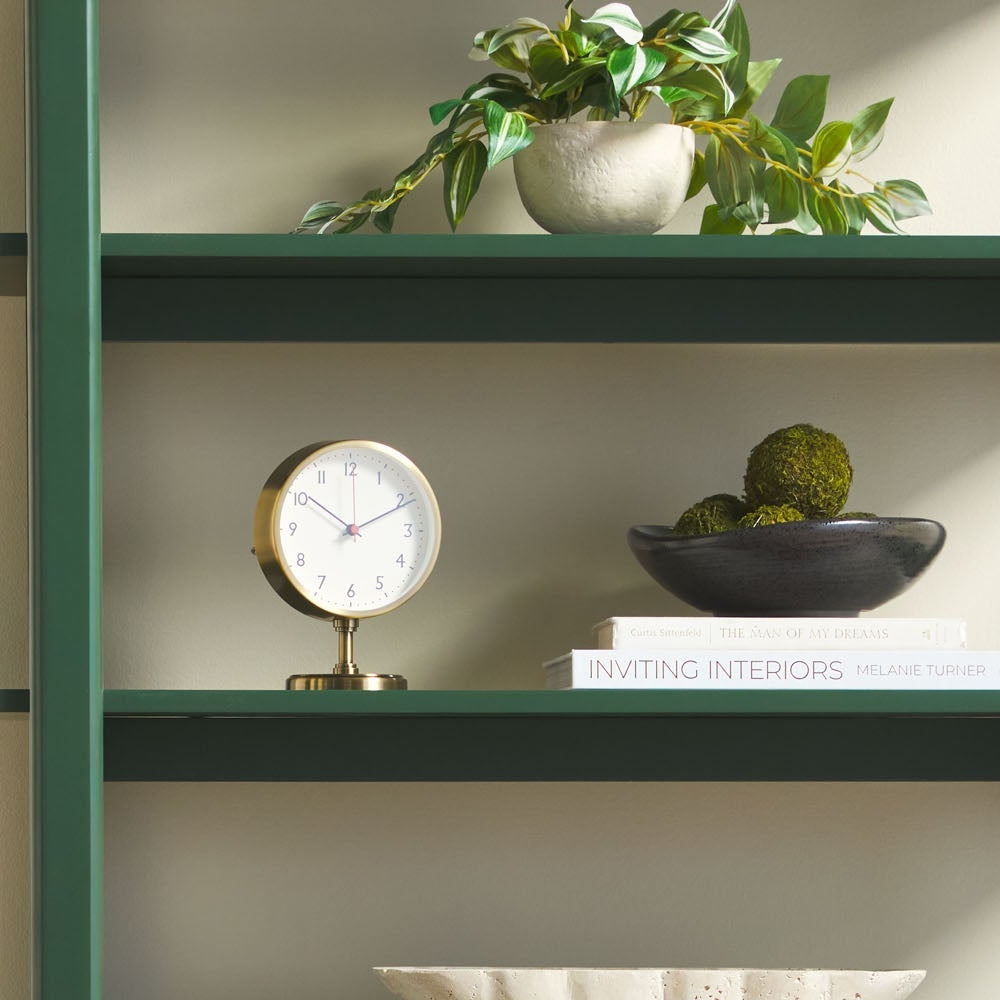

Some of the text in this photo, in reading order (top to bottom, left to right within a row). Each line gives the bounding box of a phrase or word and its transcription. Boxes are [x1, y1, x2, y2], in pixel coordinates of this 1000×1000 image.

[344, 462, 358, 477] 12
[317, 470, 326, 484] 11
[294, 492, 308, 506] 10
[397, 493, 406, 508] 2
[288, 522, 297, 536] 9
[403, 523, 412, 538] 3
[296, 552, 305, 567] 8
[395, 553, 405, 568] 4
[317, 575, 326, 590] 7
[375, 576, 384, 590] 5
[346, 584, 356, 598] 6
[719, 627, 889, 640] THE MAN OF MY DREAMS
[588, 659, 844, 680] INVITING INTERIORS
[856, 664, 987, 676] MELANIE TURNER
